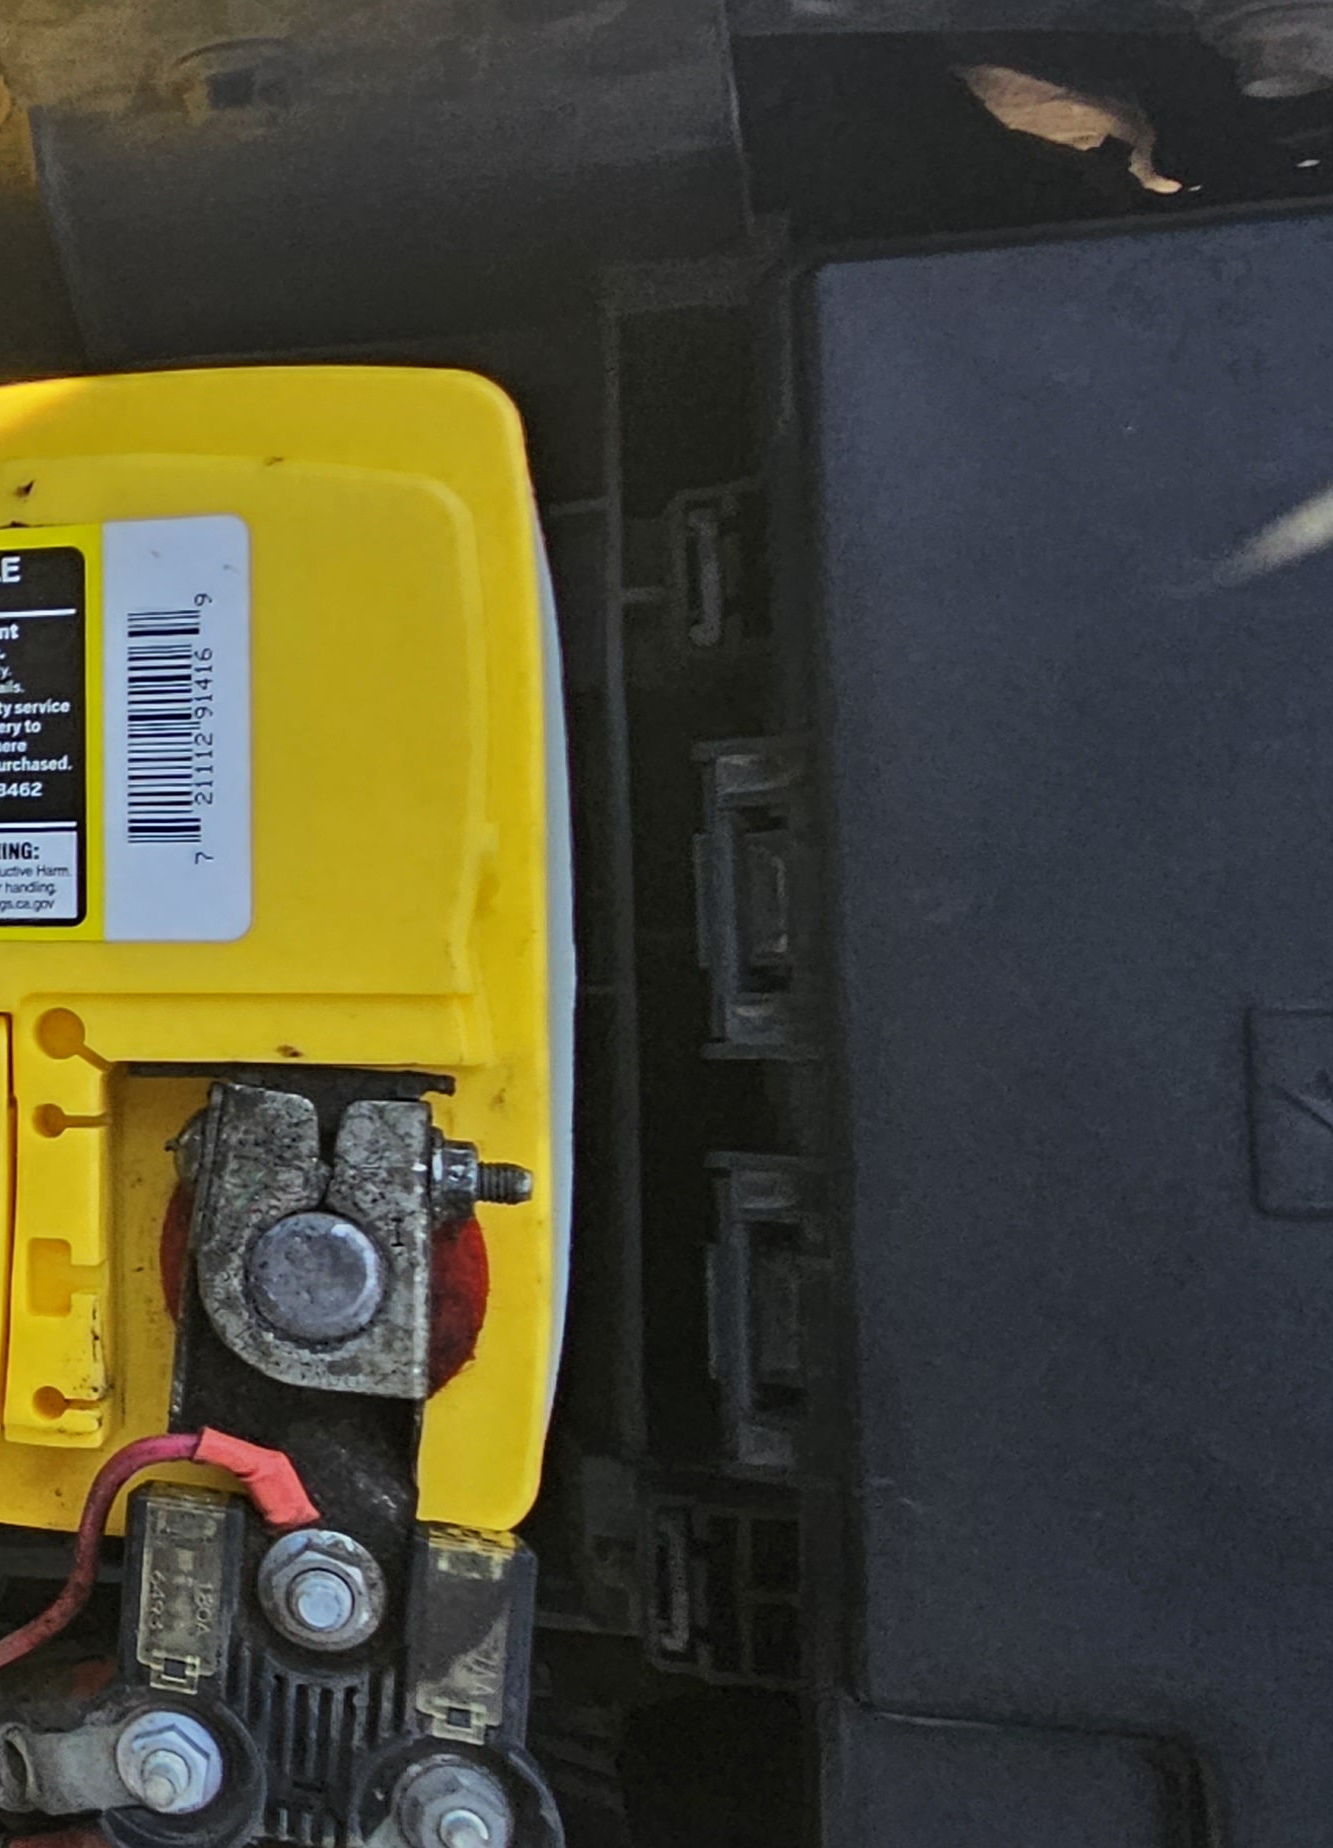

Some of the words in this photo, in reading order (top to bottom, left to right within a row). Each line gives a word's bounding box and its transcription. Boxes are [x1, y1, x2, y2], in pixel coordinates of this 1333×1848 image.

[193, 593, 215, 607] 9
[193, 647, 215, 720] 91416
[14, 699, 71, 715] service
[24, 720, 42, 734] to
[193, 732, 215, 806] 21112
[193, 852, 215, 866] 7
[36, 864, 71, 878] Harm.
[4, 880, 57, 896] handling.
